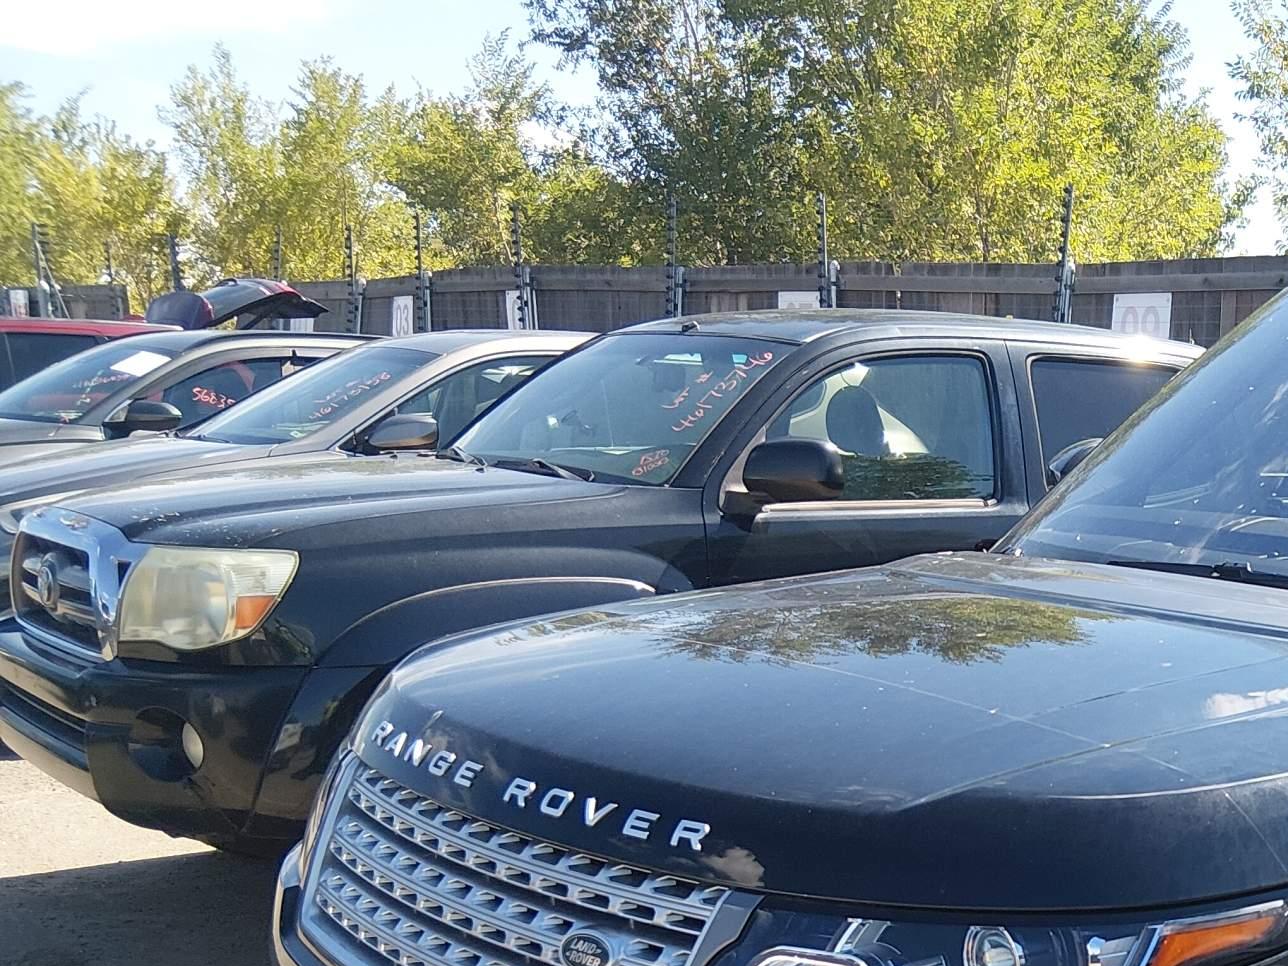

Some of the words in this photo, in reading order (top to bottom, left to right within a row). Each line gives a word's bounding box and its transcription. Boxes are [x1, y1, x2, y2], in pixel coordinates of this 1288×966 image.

[371, 720, 484, 788] RANGE
[503, 777, 711, 851] ROVER
[570, 937, 598, 954] LAND
